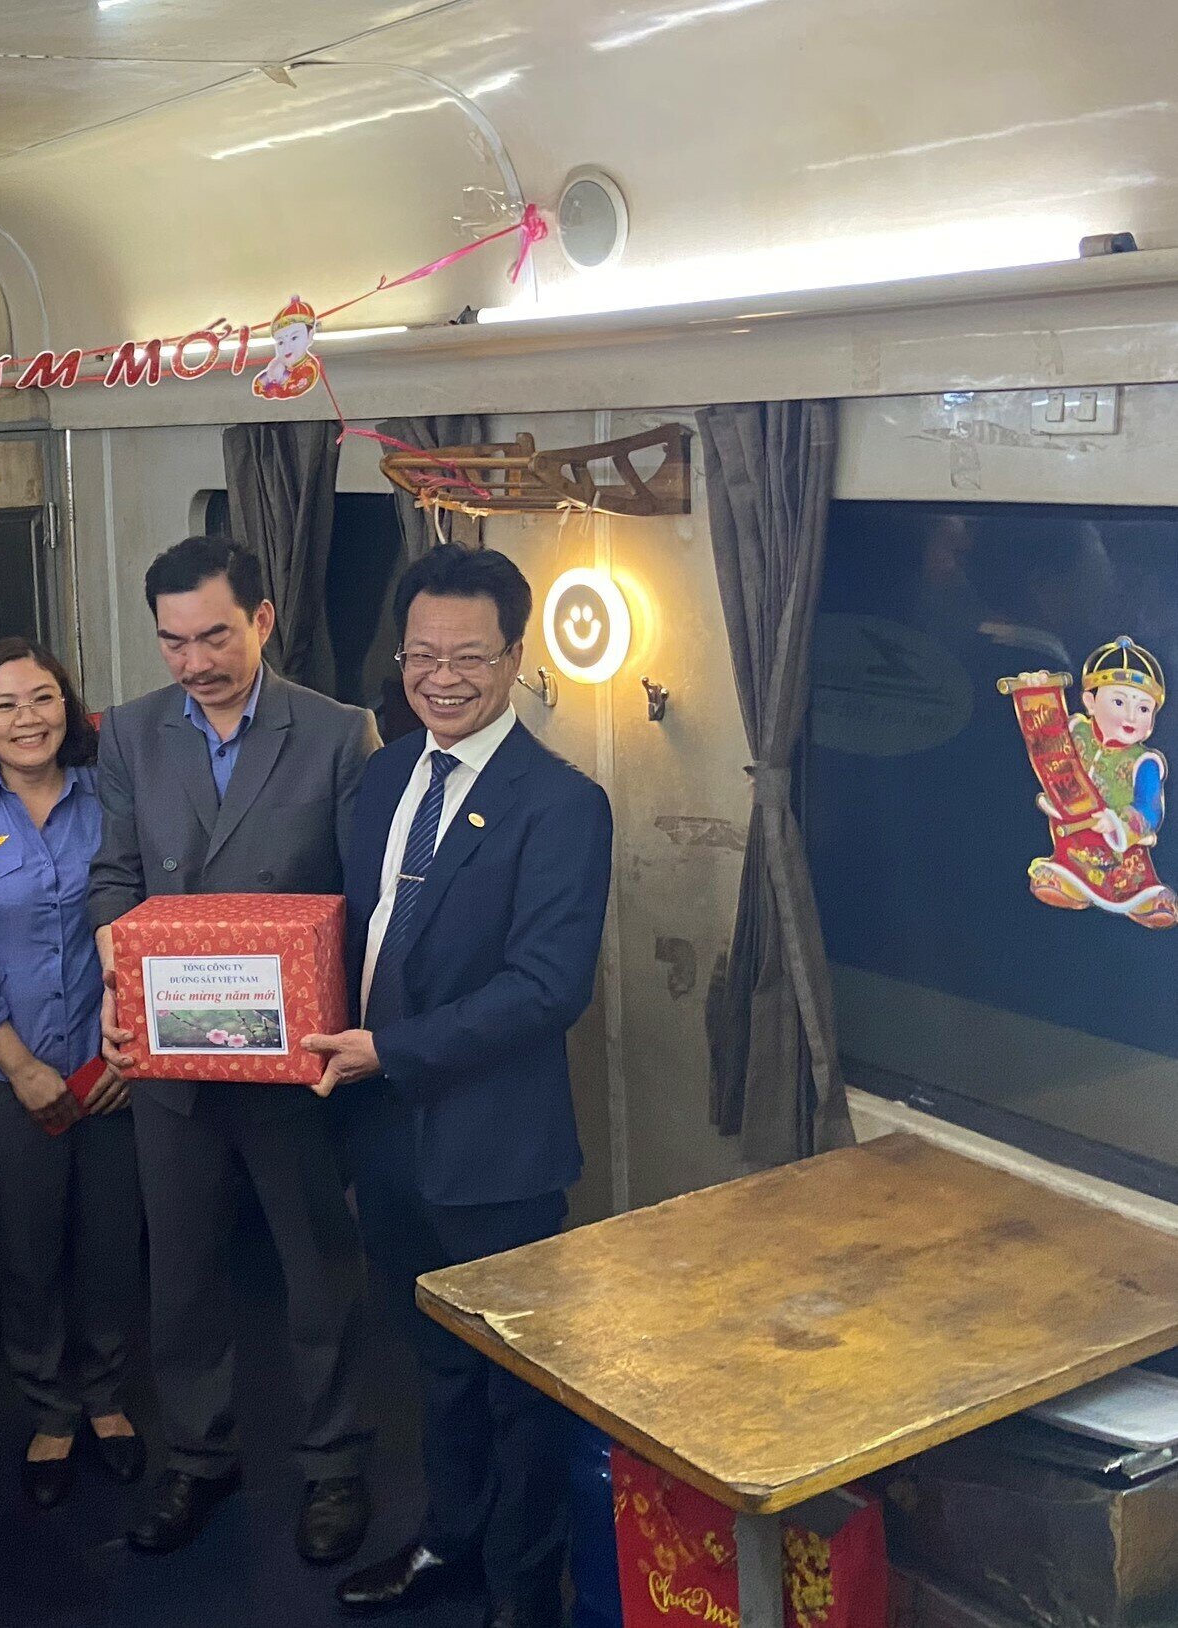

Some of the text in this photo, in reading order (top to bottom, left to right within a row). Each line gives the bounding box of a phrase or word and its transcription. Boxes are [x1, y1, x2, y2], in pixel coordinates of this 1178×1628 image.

[104, 317, 249, 388] MỚI
[207, 963, 231, 971] CÔNG
[233, 963, 244, 971] TY
[156, 990, 185, 1001] Chúc
[225, 990, 250, 1001] năm
[253, 990, 276, 1001] mới
